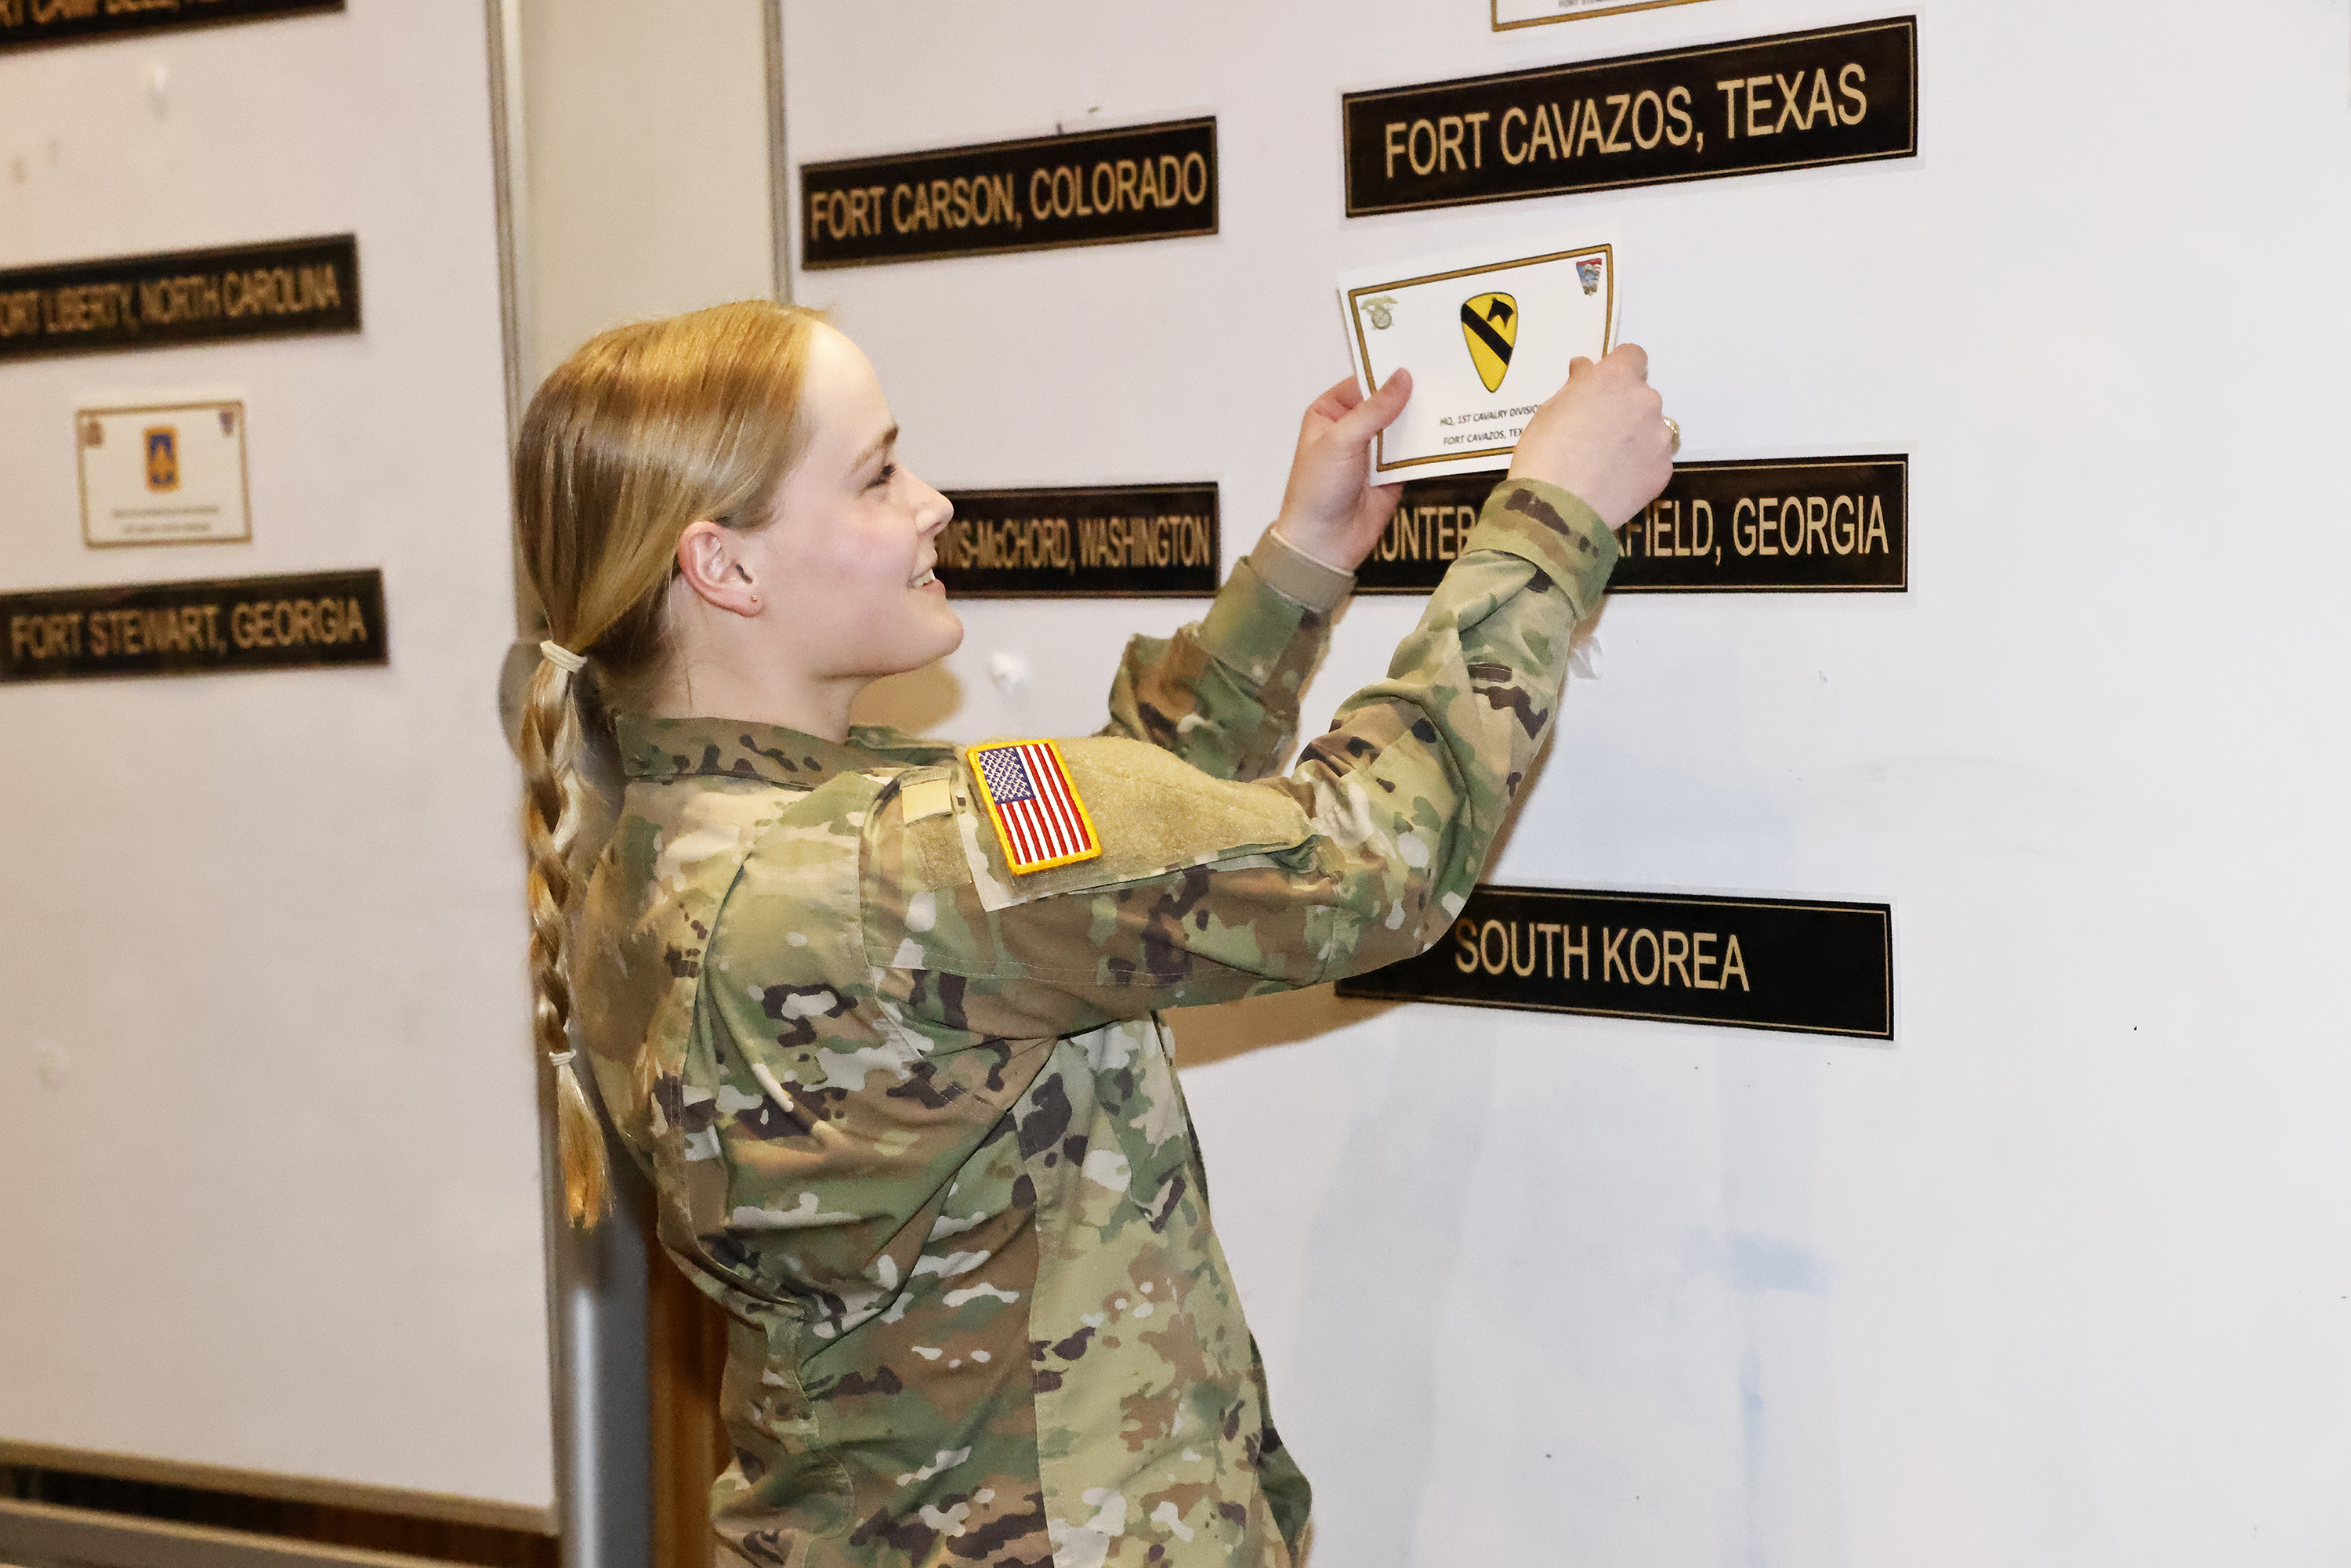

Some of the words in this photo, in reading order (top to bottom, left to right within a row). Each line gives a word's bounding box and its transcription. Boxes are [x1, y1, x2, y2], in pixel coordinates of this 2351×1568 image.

[1384, 112, 1490, 179] FORT
[1500, 85, 1705, 165] CAVAZOS,
[1717, 63, 1868, 139] TEXAS
[810, 186, 886, 240] FORT
[892, 172, 1023, 234] CARSON,
[1029, 150, 1208, 220] COLORADO
[0, 289, 38, 337] ORT
[223, 263, 341, 318] CAROLINA
[1444, 435, 1464, 446] FORT
[1467, 430, 1506, 444] CAVAZOS,
[1509, 427, 1524, 437] TEX
[1458, 414, 1472, 425] 1ST
[1473, 409, 1508, 422] CAVALRY
[1509, 404, 1541, 418] DIVISIO
[1077, 514, 1211, 568] WASHINGTON
[1374, 505, 1476, 563] UNTER
[1613, 498, 1722, 567] FIELD,
[1733, 494, 1889, 557] GEORGIA
[11, 612, 82, 660] FORT
[89, 604, 227, 657] STEWART,
[233, 597, 368, 650] GEORGIA
[1454, 918, 1589, 981] SOUTH
[1603, 928, 1750, 993] KOREA
